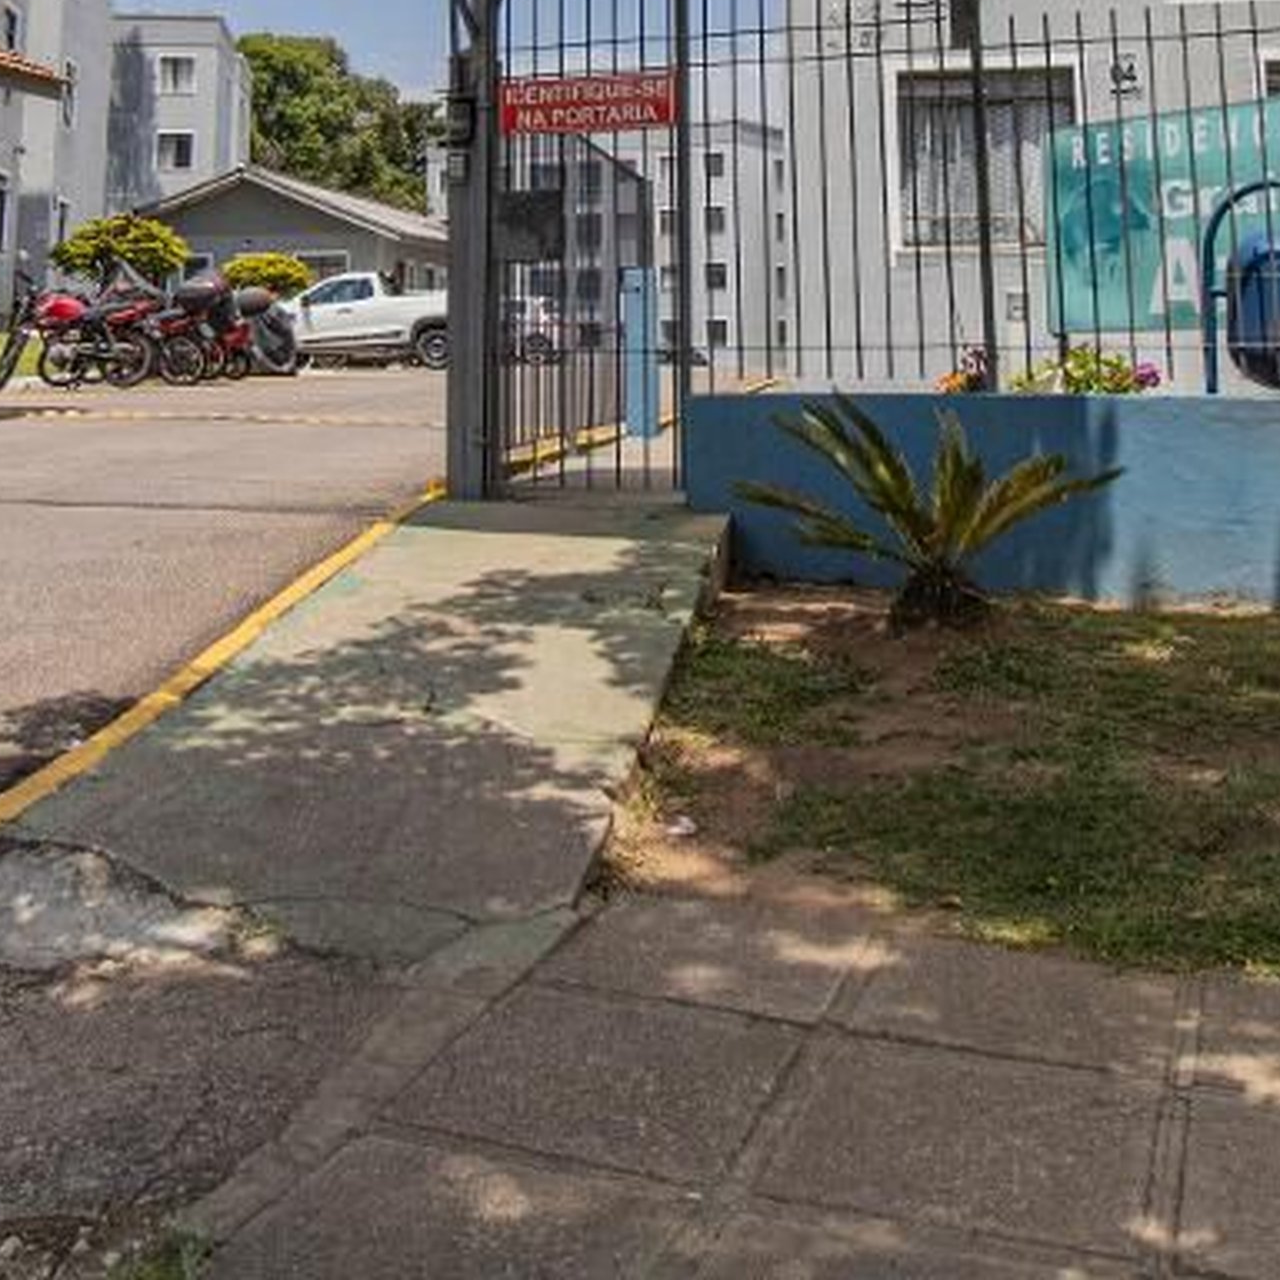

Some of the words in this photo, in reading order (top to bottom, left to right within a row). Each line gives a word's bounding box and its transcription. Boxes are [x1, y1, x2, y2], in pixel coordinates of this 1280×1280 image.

[505, 79, 668, 106] IDENTIFIQUE-SE
[516, 107, 547, 129] NA
[551, 103, 658, 126] PORTARIA
